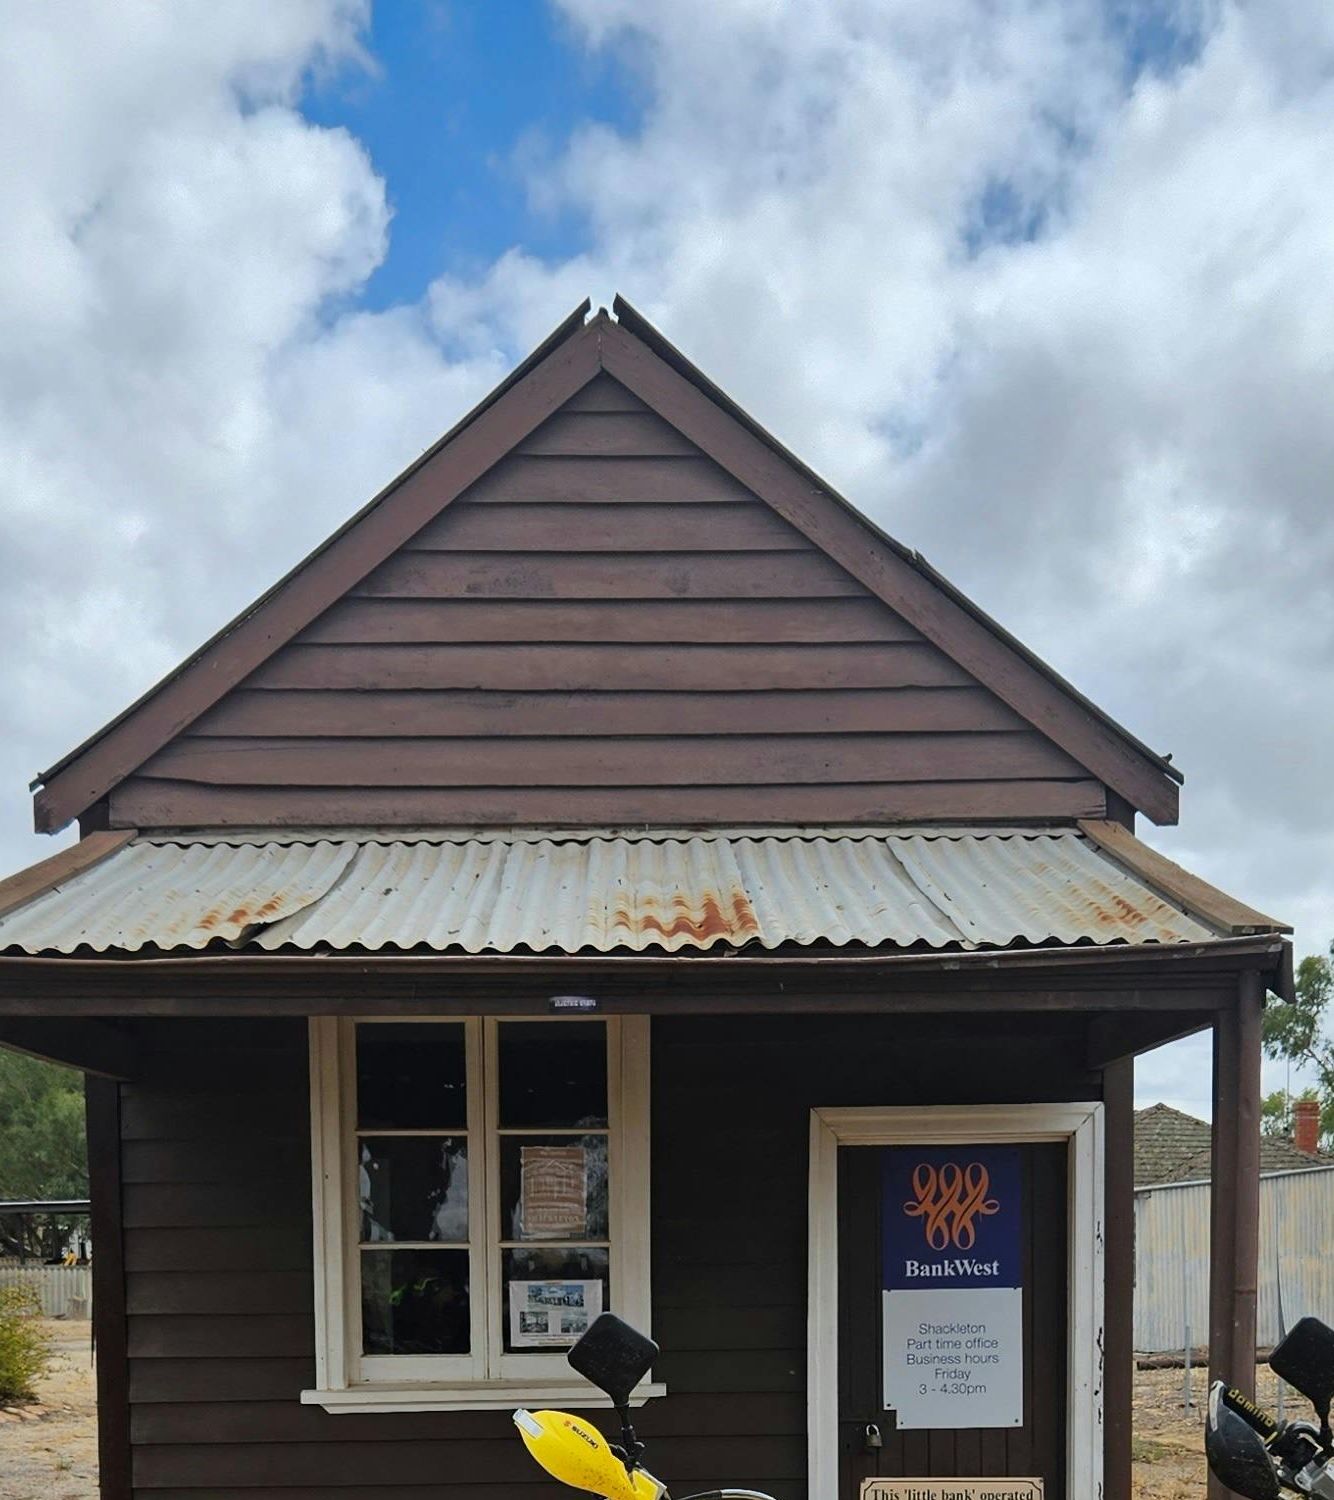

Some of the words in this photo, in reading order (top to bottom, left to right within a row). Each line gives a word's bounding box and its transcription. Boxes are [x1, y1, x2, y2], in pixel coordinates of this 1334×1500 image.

[905, 1259, 1000, 1277] BankWest
[918, 1323, 986, 1335] Shackleton
[907, 1339, 932, 1350] Part
[936, 1338, 962, 1349] time
[965, 1337, 999, 1349] office
[907, 1353, 961, 1365] Business
[965, 1352, 1000, 1364] hours
[935, 1368, 971, 1381] Friday
[919, 1383, 927, 1395] 3
[939, 1383, 987, 1396] 4.30pm
[871, 1489, 900, 1500] This
